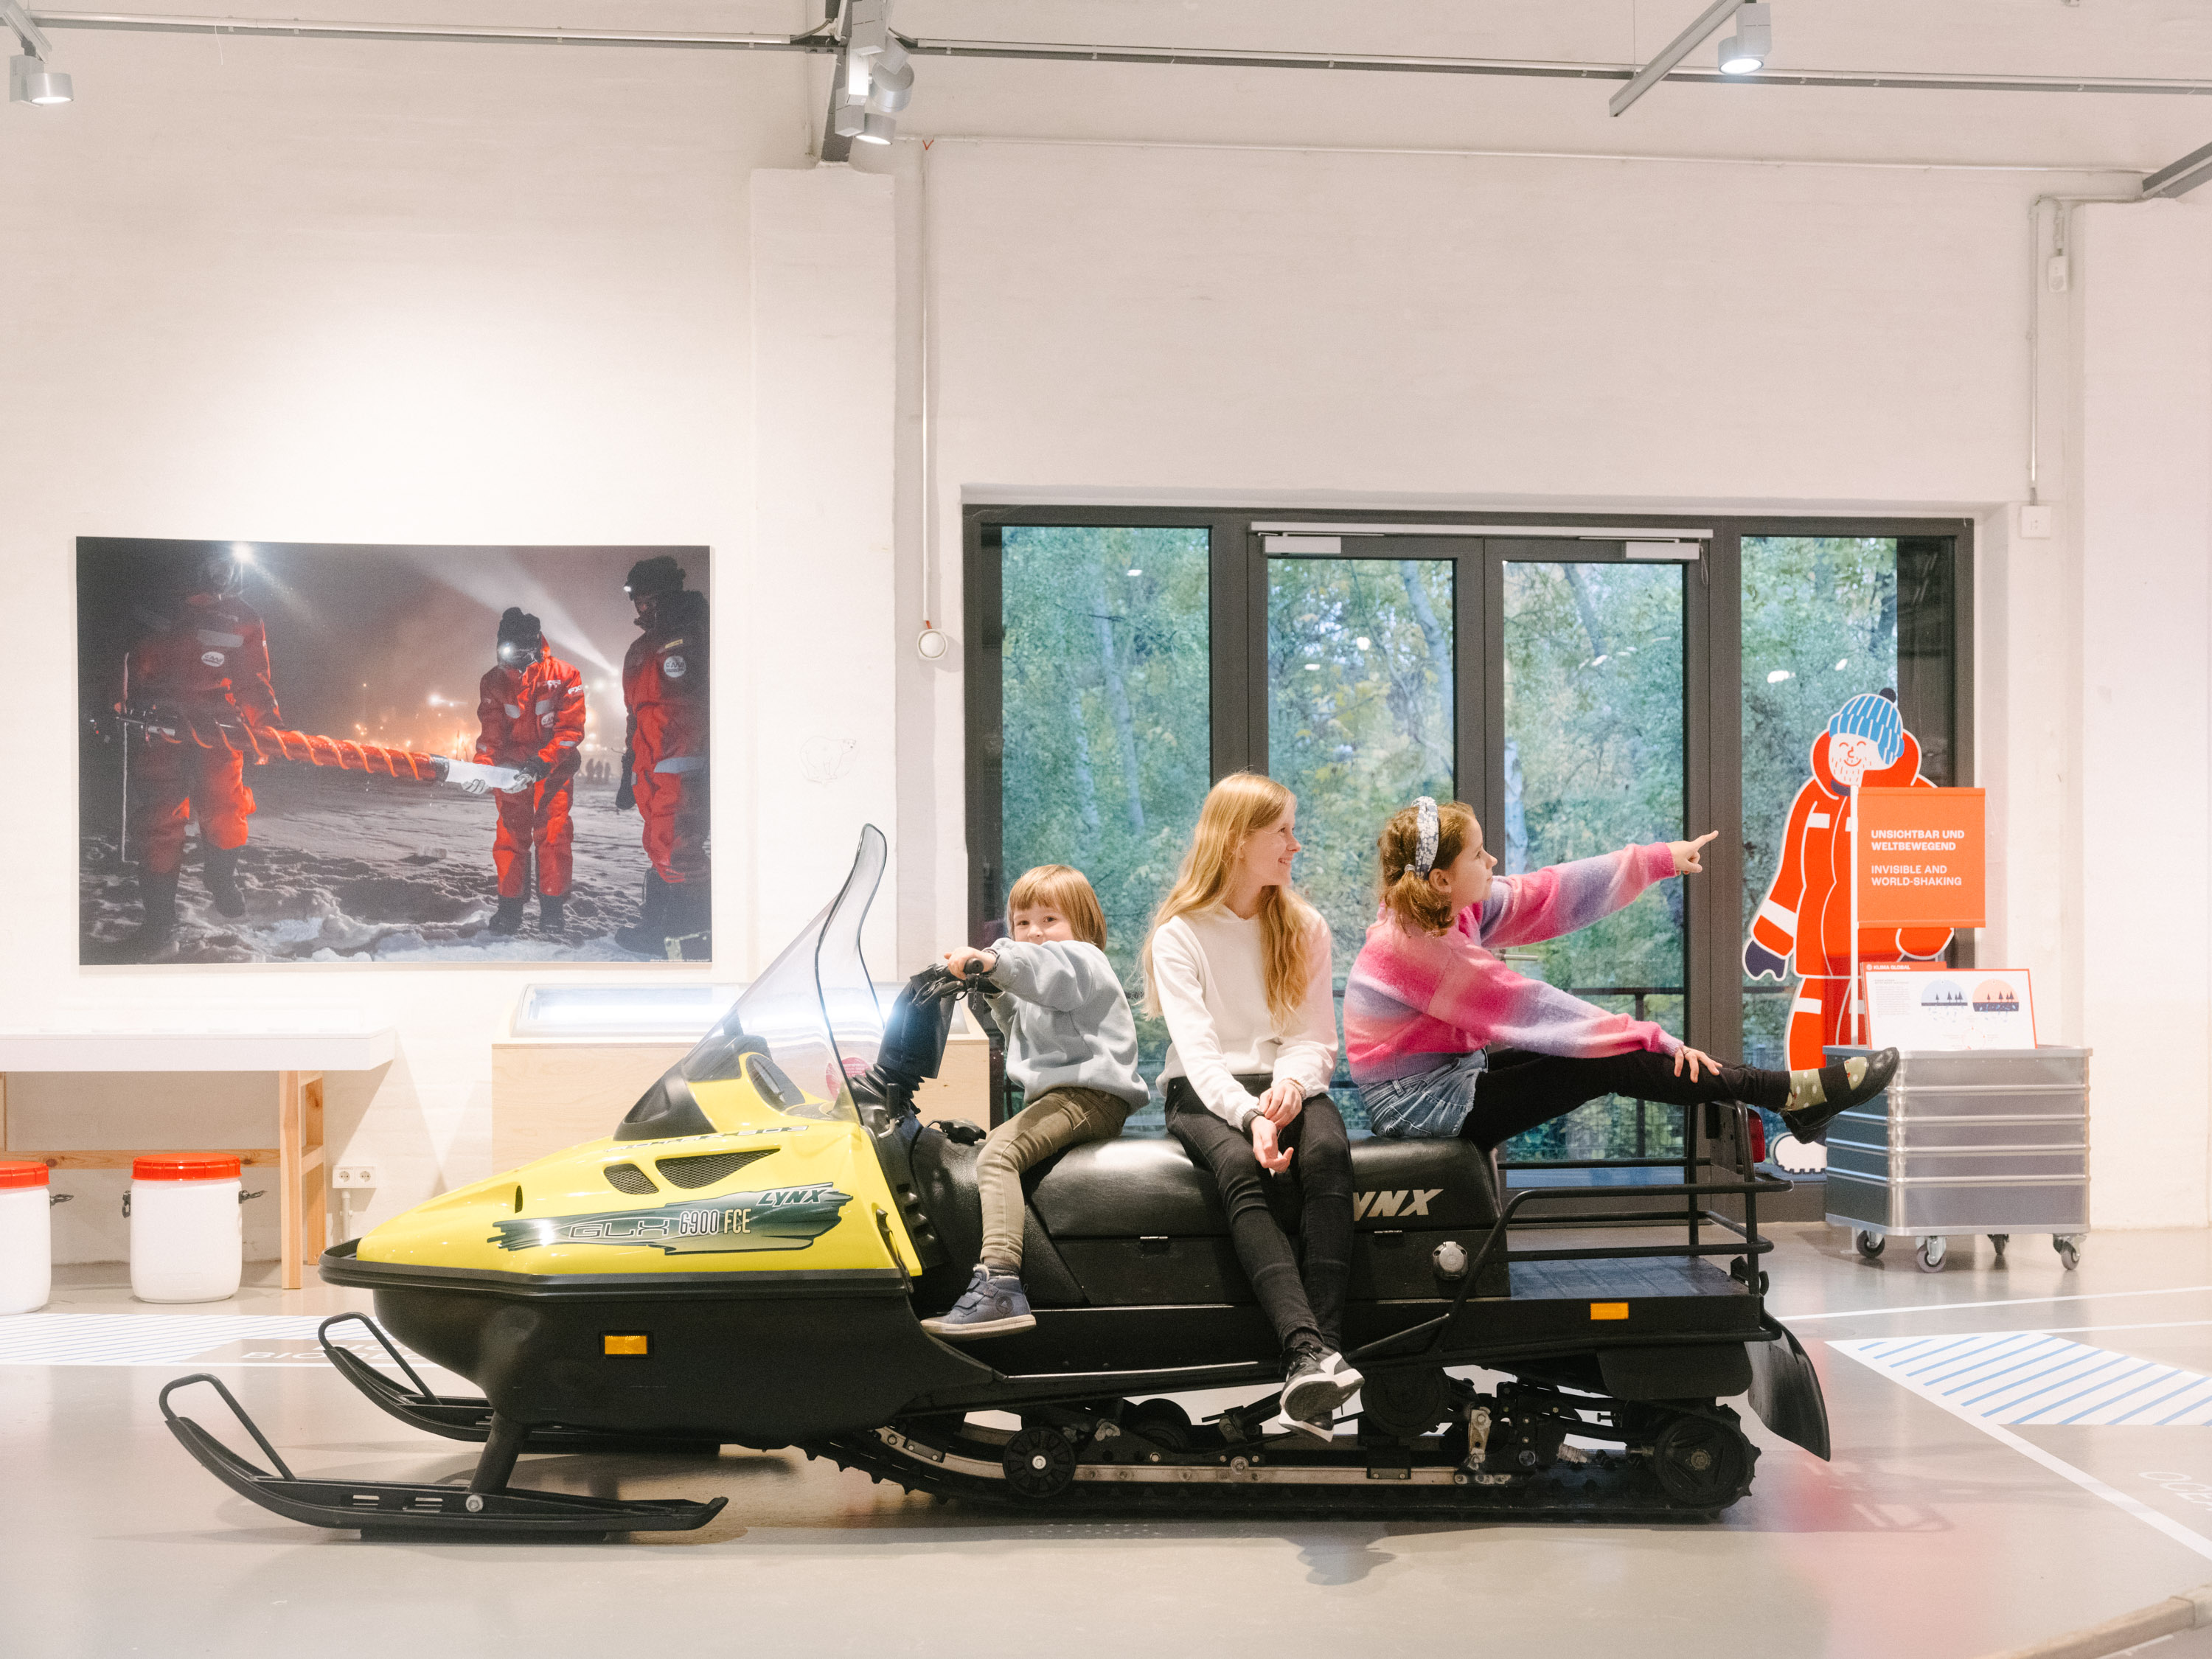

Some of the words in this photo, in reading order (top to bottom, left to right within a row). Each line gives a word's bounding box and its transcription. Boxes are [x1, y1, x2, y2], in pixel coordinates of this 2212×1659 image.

[1871, 830, 1940, 839] UNSICHTBAR
[1942, 830, 1965, 839] UND
[1871, 841, 1957, 851] WELTBEWEGEND
[1871, 865, 1922, 874] INVISIBLE
[1924, 865, 1947, 874] AND
[1871, 877, 1963, 886] WORLD-SHAKING
[756, 1189, 827, 1208] LYNX
[1352, 1188, 1444, 1222] YNX
[568, 1219, 669, 1239] GLX
[678, 1210, 720, 1236] 6900
[723, 1208, 752, 1234] FCE
